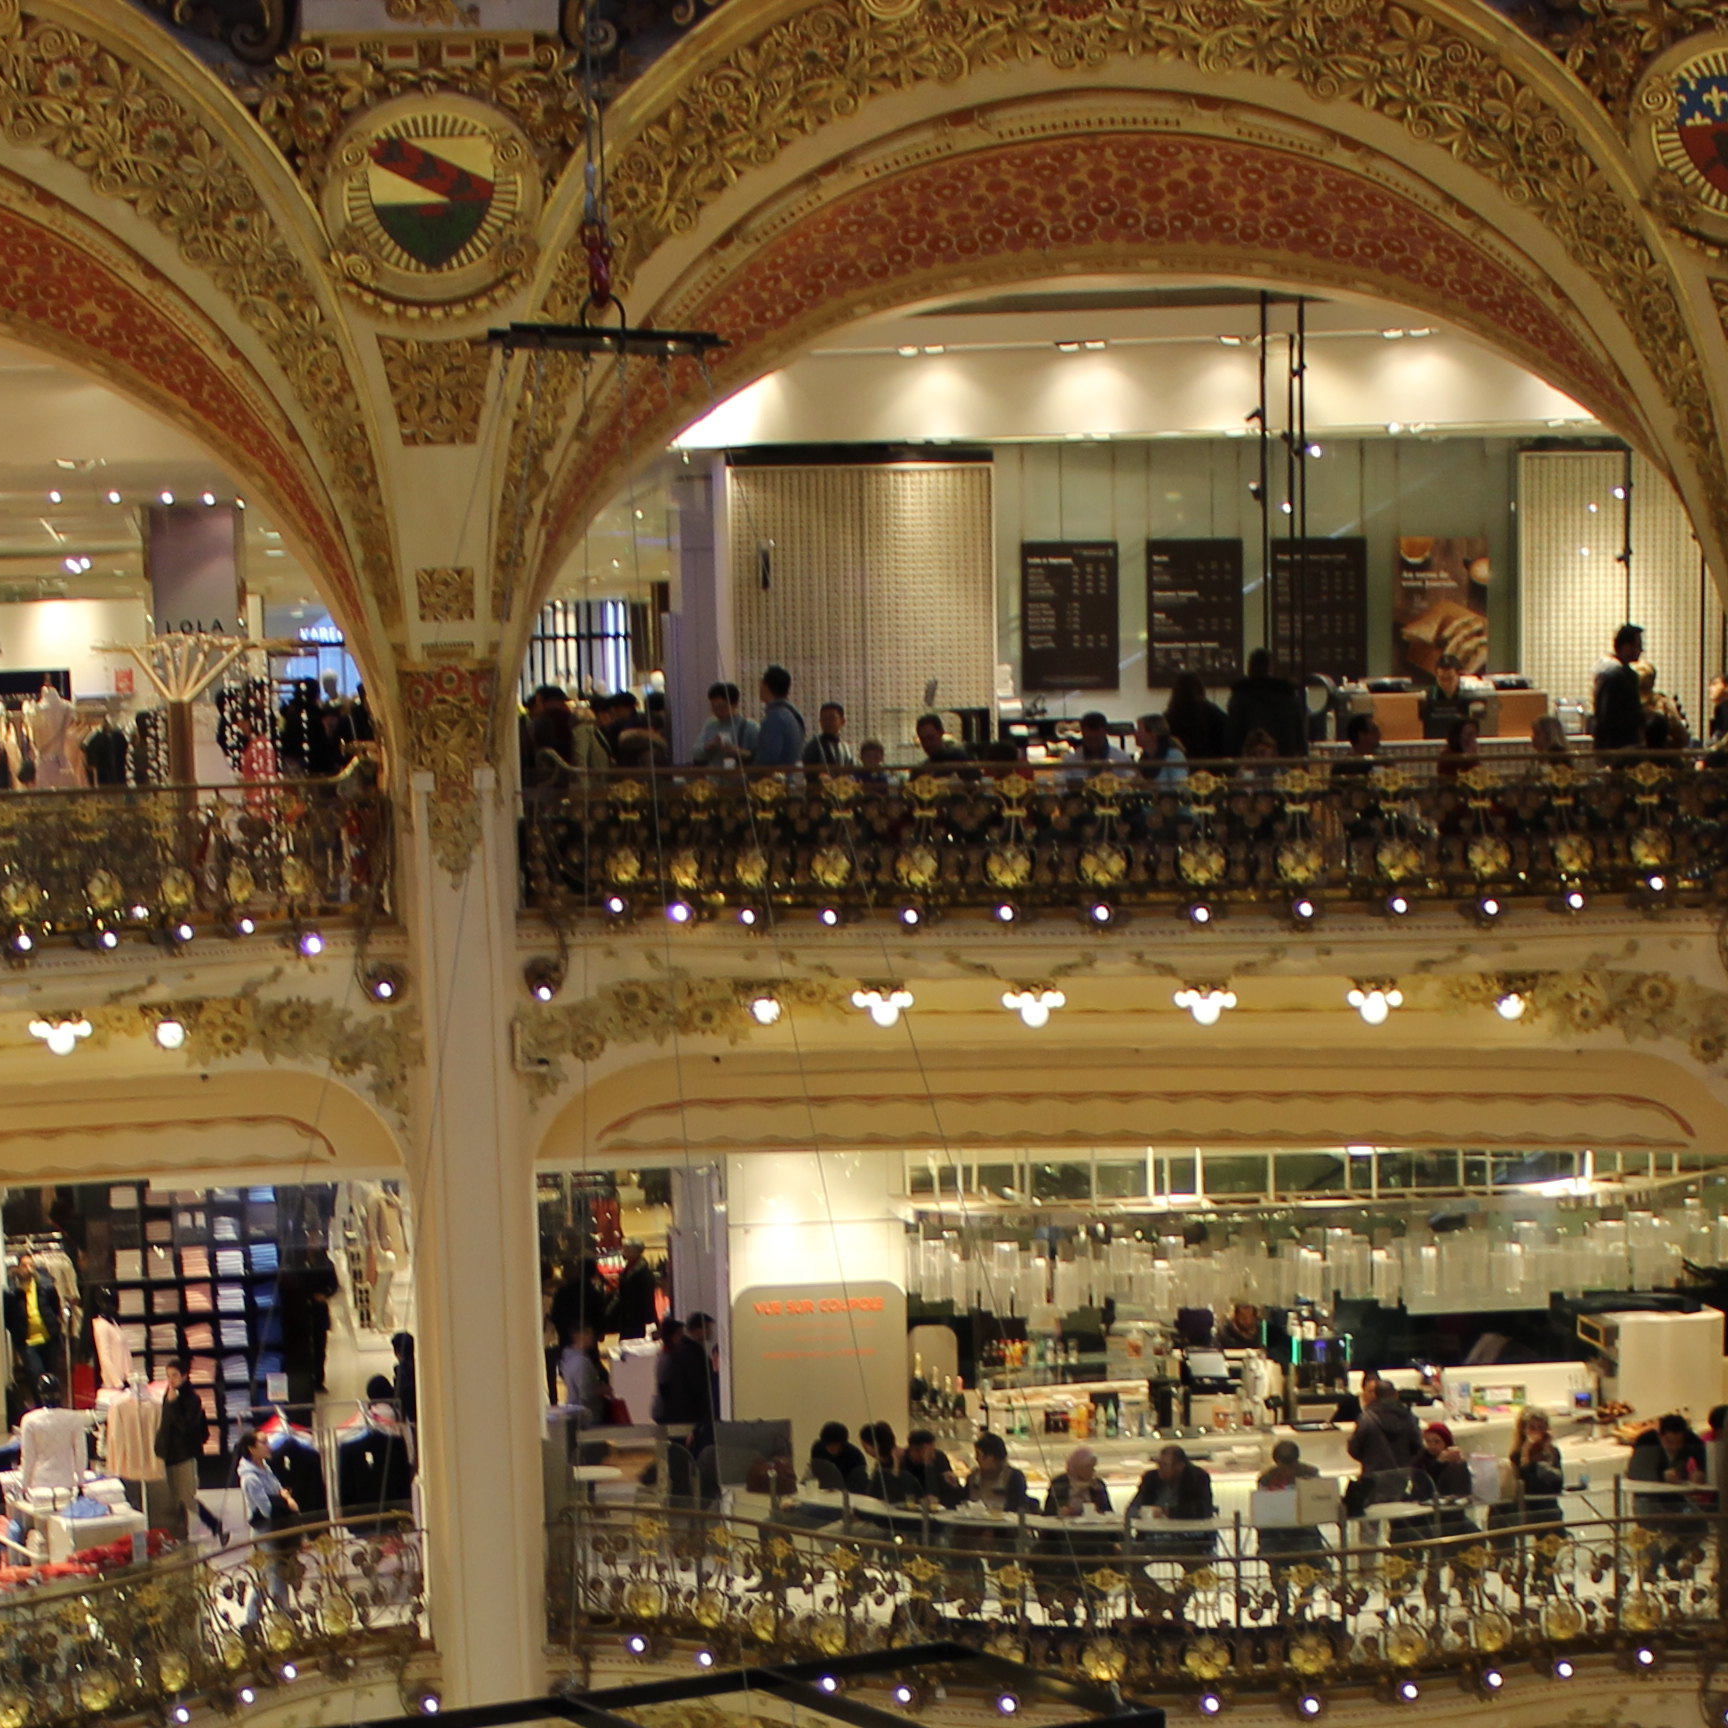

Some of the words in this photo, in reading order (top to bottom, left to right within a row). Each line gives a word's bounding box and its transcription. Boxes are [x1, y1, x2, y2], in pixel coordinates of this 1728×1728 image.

[166, 618, 224, 634] LOLA
[753, 1301, 783, 1315] VUE
[786, 1299, 815, 1313] SUR
[819, 1297, 885, 1312] COUPOLE
